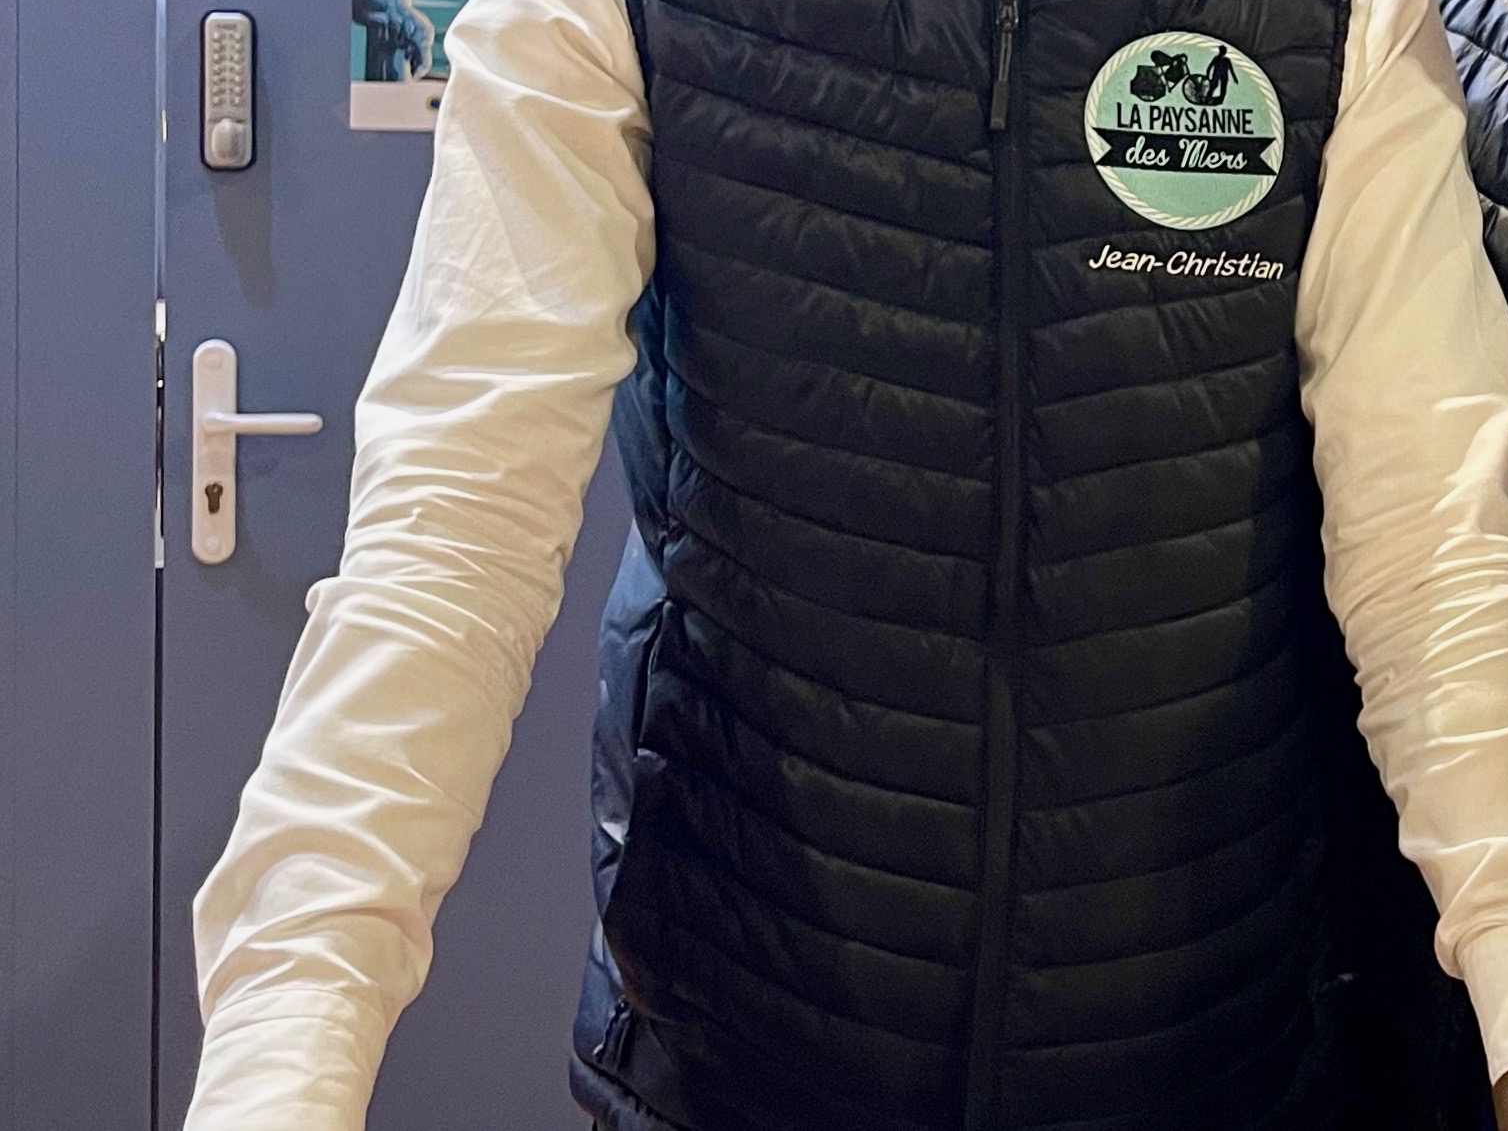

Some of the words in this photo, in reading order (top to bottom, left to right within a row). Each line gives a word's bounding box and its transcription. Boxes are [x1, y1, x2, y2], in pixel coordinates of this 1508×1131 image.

[1116, 102, 1142, 130] LA
[1149, 105, 1255, 135] PAYSANNE
[1125, 136, 1170, 166] des
[1179, 138, 1248, 170] Mers
[1089, 244, 1285, 281] Jean-Christian
